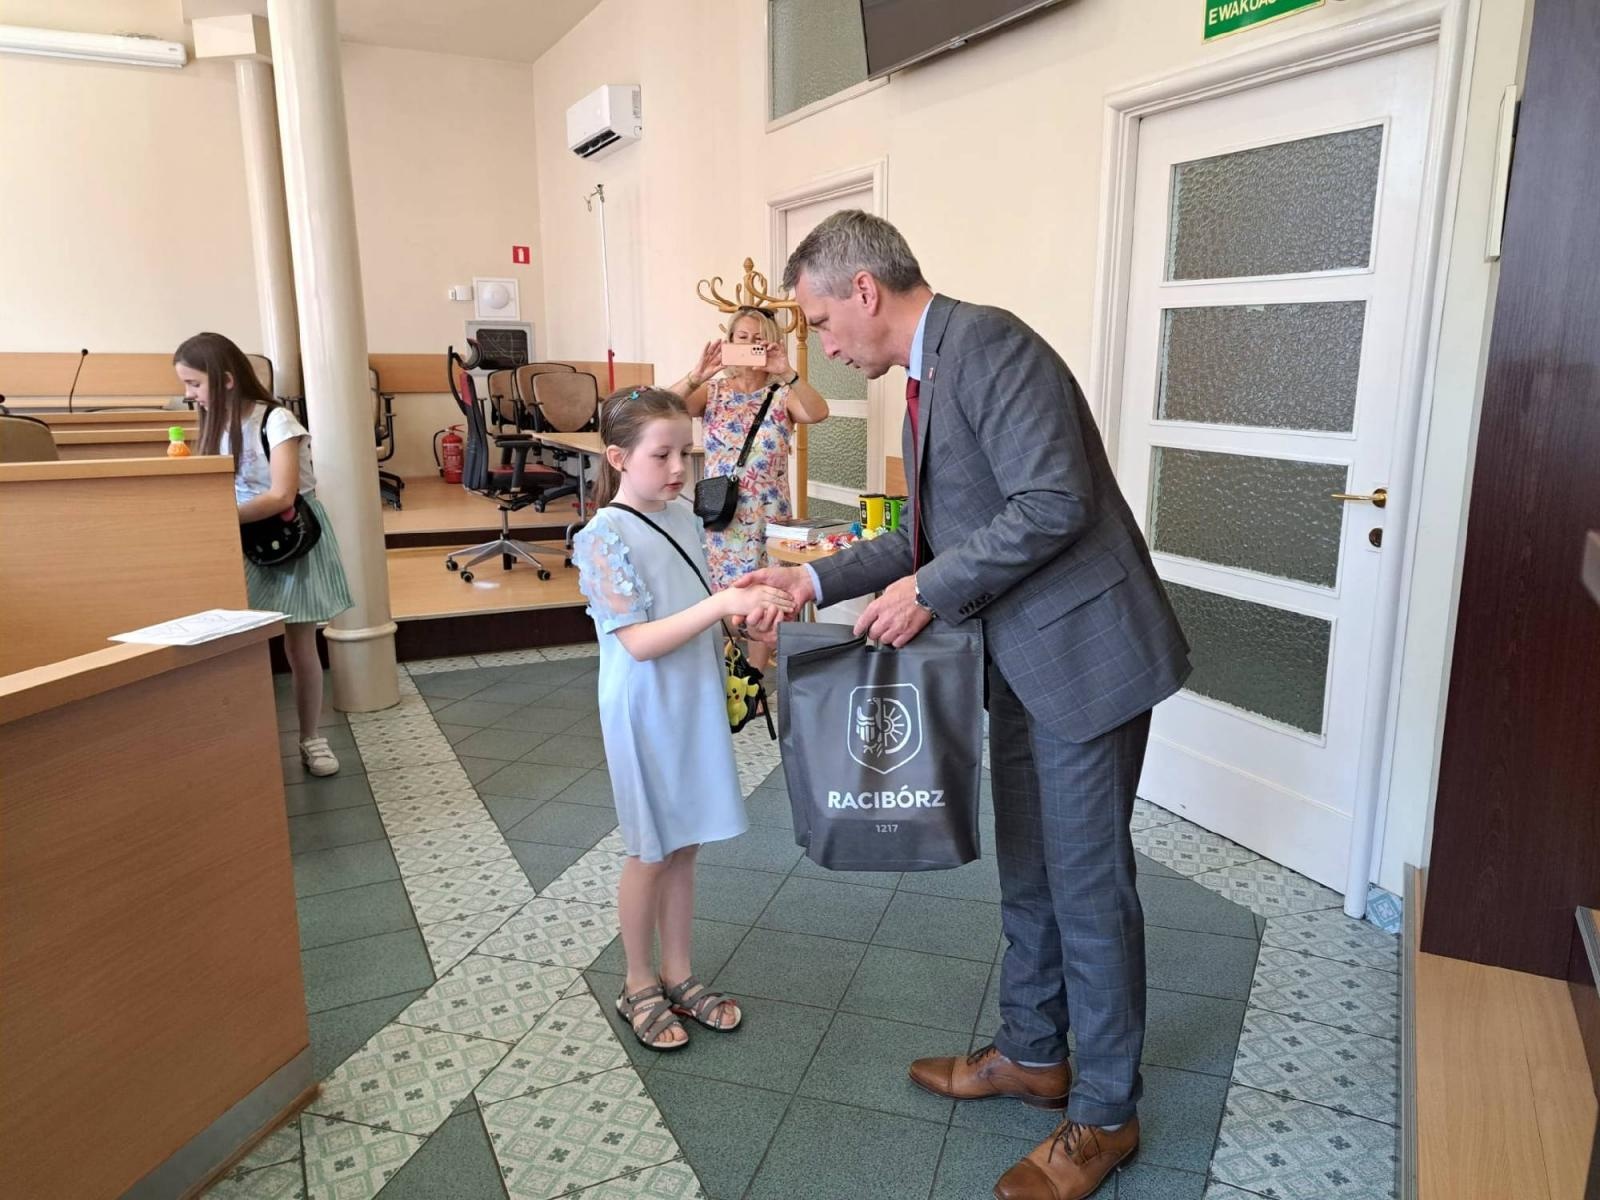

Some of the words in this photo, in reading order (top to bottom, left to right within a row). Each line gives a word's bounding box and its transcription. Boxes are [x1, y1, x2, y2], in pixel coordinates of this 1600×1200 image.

[1208, 0, 1277, 25] EWAKUA
[827, 784, 946, 809] RACIBÓRZ
[875, 824, 899, 833] 1217
